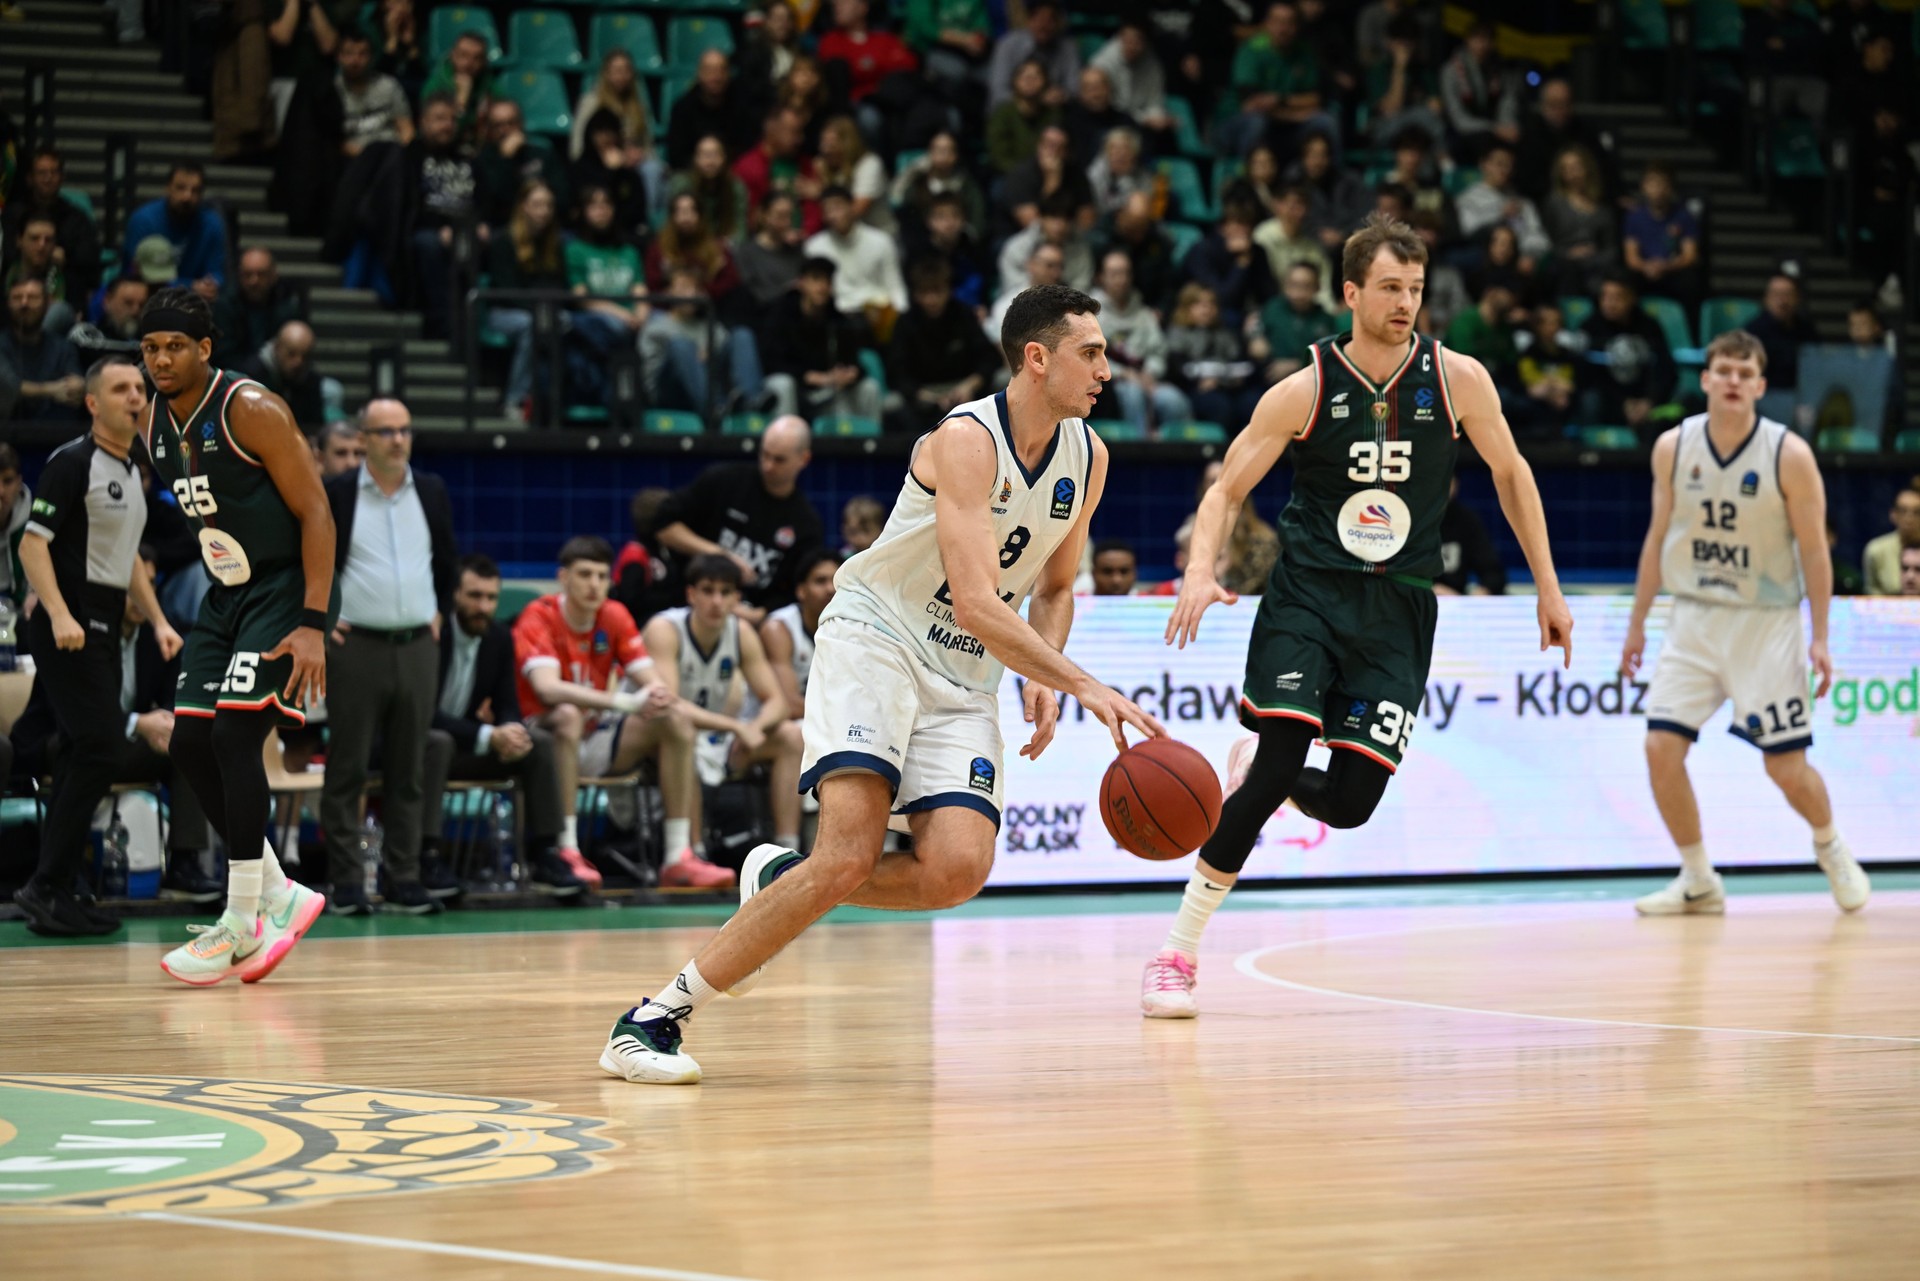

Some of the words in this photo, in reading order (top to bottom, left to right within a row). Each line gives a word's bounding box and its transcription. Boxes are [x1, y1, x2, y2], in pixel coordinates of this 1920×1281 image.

[1422, 353, 1431, 372] C
[1348, 441, 1412, 484] 35
[173, 475, 218, 517] 25
[1055, 502, 1069, 510] BKT
[1051, 509, 1070, 517] EuroCup
[1701, 500, 1737, 531] 12
[999, 525, 1031, 569] 8
[1347, 528, 1395, 541] aquapark
[1692, 539, 1750, 569] BAXI
[926, 622, 985, 659] MARESA
[1015, 670, 1242, 722] cław
[1766, 697, 1807, 733] 12
[846, 736, 873, 745] GLOBAL
[848, 729, 863, 737] ETL
[1006, 803, 1085, 827] DOLNY
